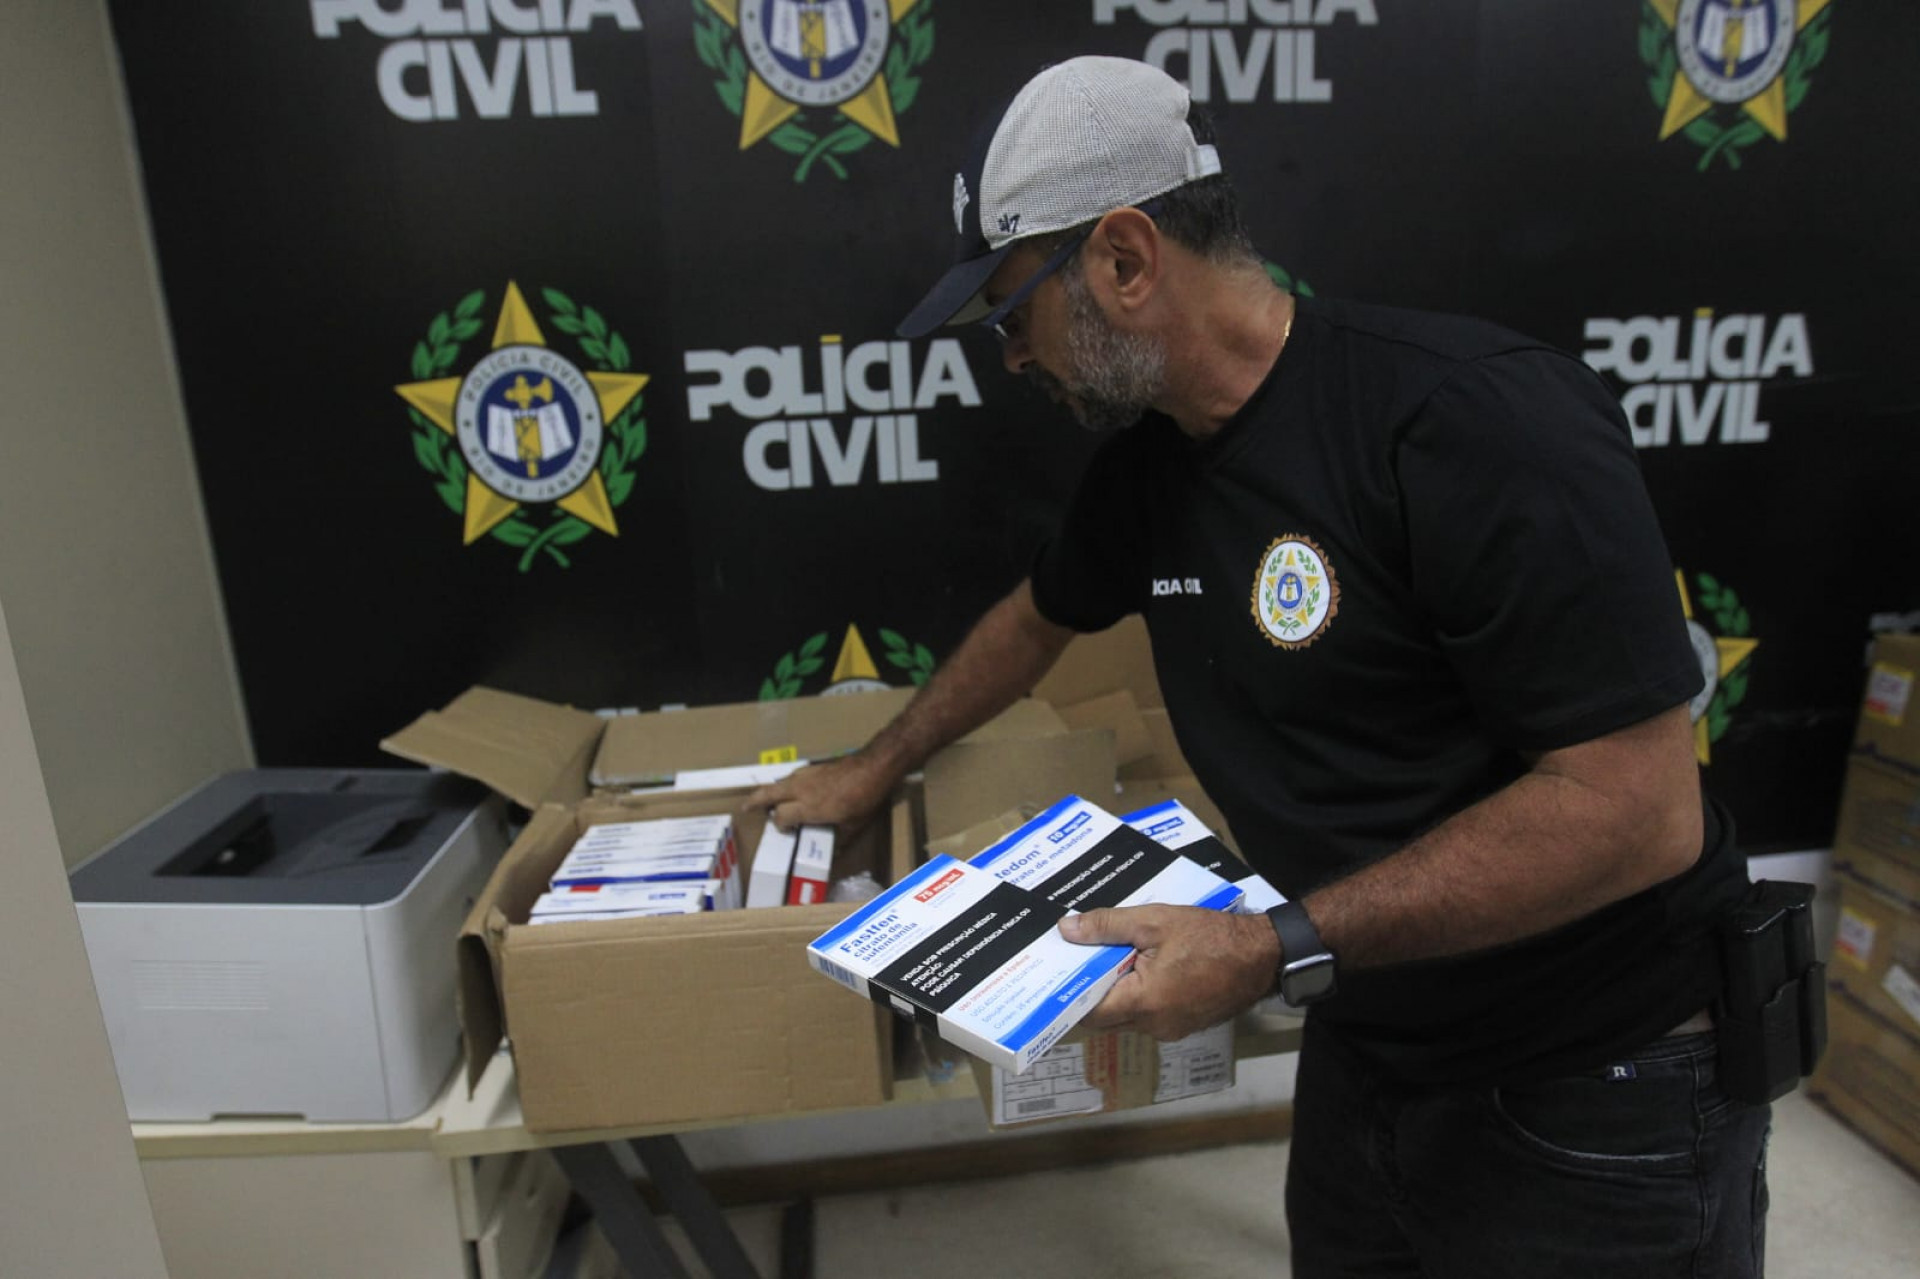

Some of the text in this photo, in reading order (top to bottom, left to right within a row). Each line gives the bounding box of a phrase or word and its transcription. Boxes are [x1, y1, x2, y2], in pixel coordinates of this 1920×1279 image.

[376, 37, 599, 121] CIVIL
[1620, 381, 1770, 447] CIVIL
[743, 413, 939, 491] CIVIL
[993, 847, 1041, 881] tedom
[850, 932, 889, 958] citrato
[885, 922, 903, 933] de
